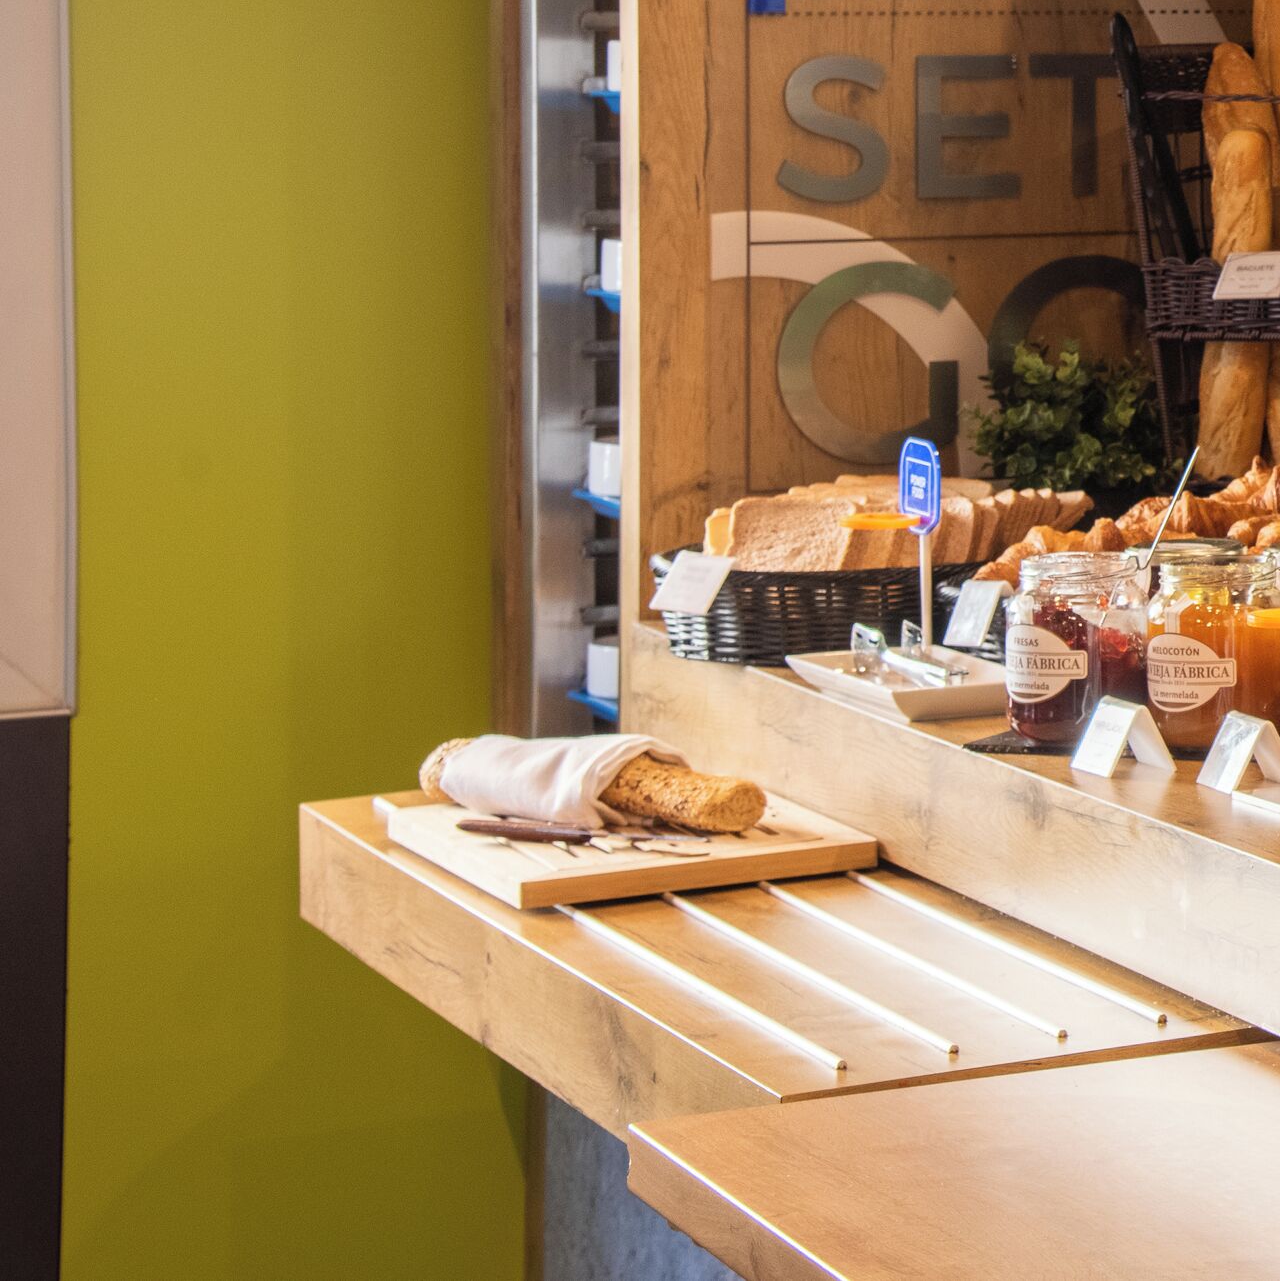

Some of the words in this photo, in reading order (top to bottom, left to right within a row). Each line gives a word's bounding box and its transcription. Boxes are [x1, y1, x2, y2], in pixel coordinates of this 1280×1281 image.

[776, 53, 1118, 203] SET
[1013, 637, 1040, 648] FRESAS
[1152, 645, 1200, 657] MELOCOTÓN
[1026, 654, 1081, 670] FÁBRICA
[1148, 663, 1170, 679] VIEJA
[1173, 663, 1230, 679] FÁBRICA
[1014, 681, 1050, 691] mermelada
[1160, 690, 1199, 700] mermelada
